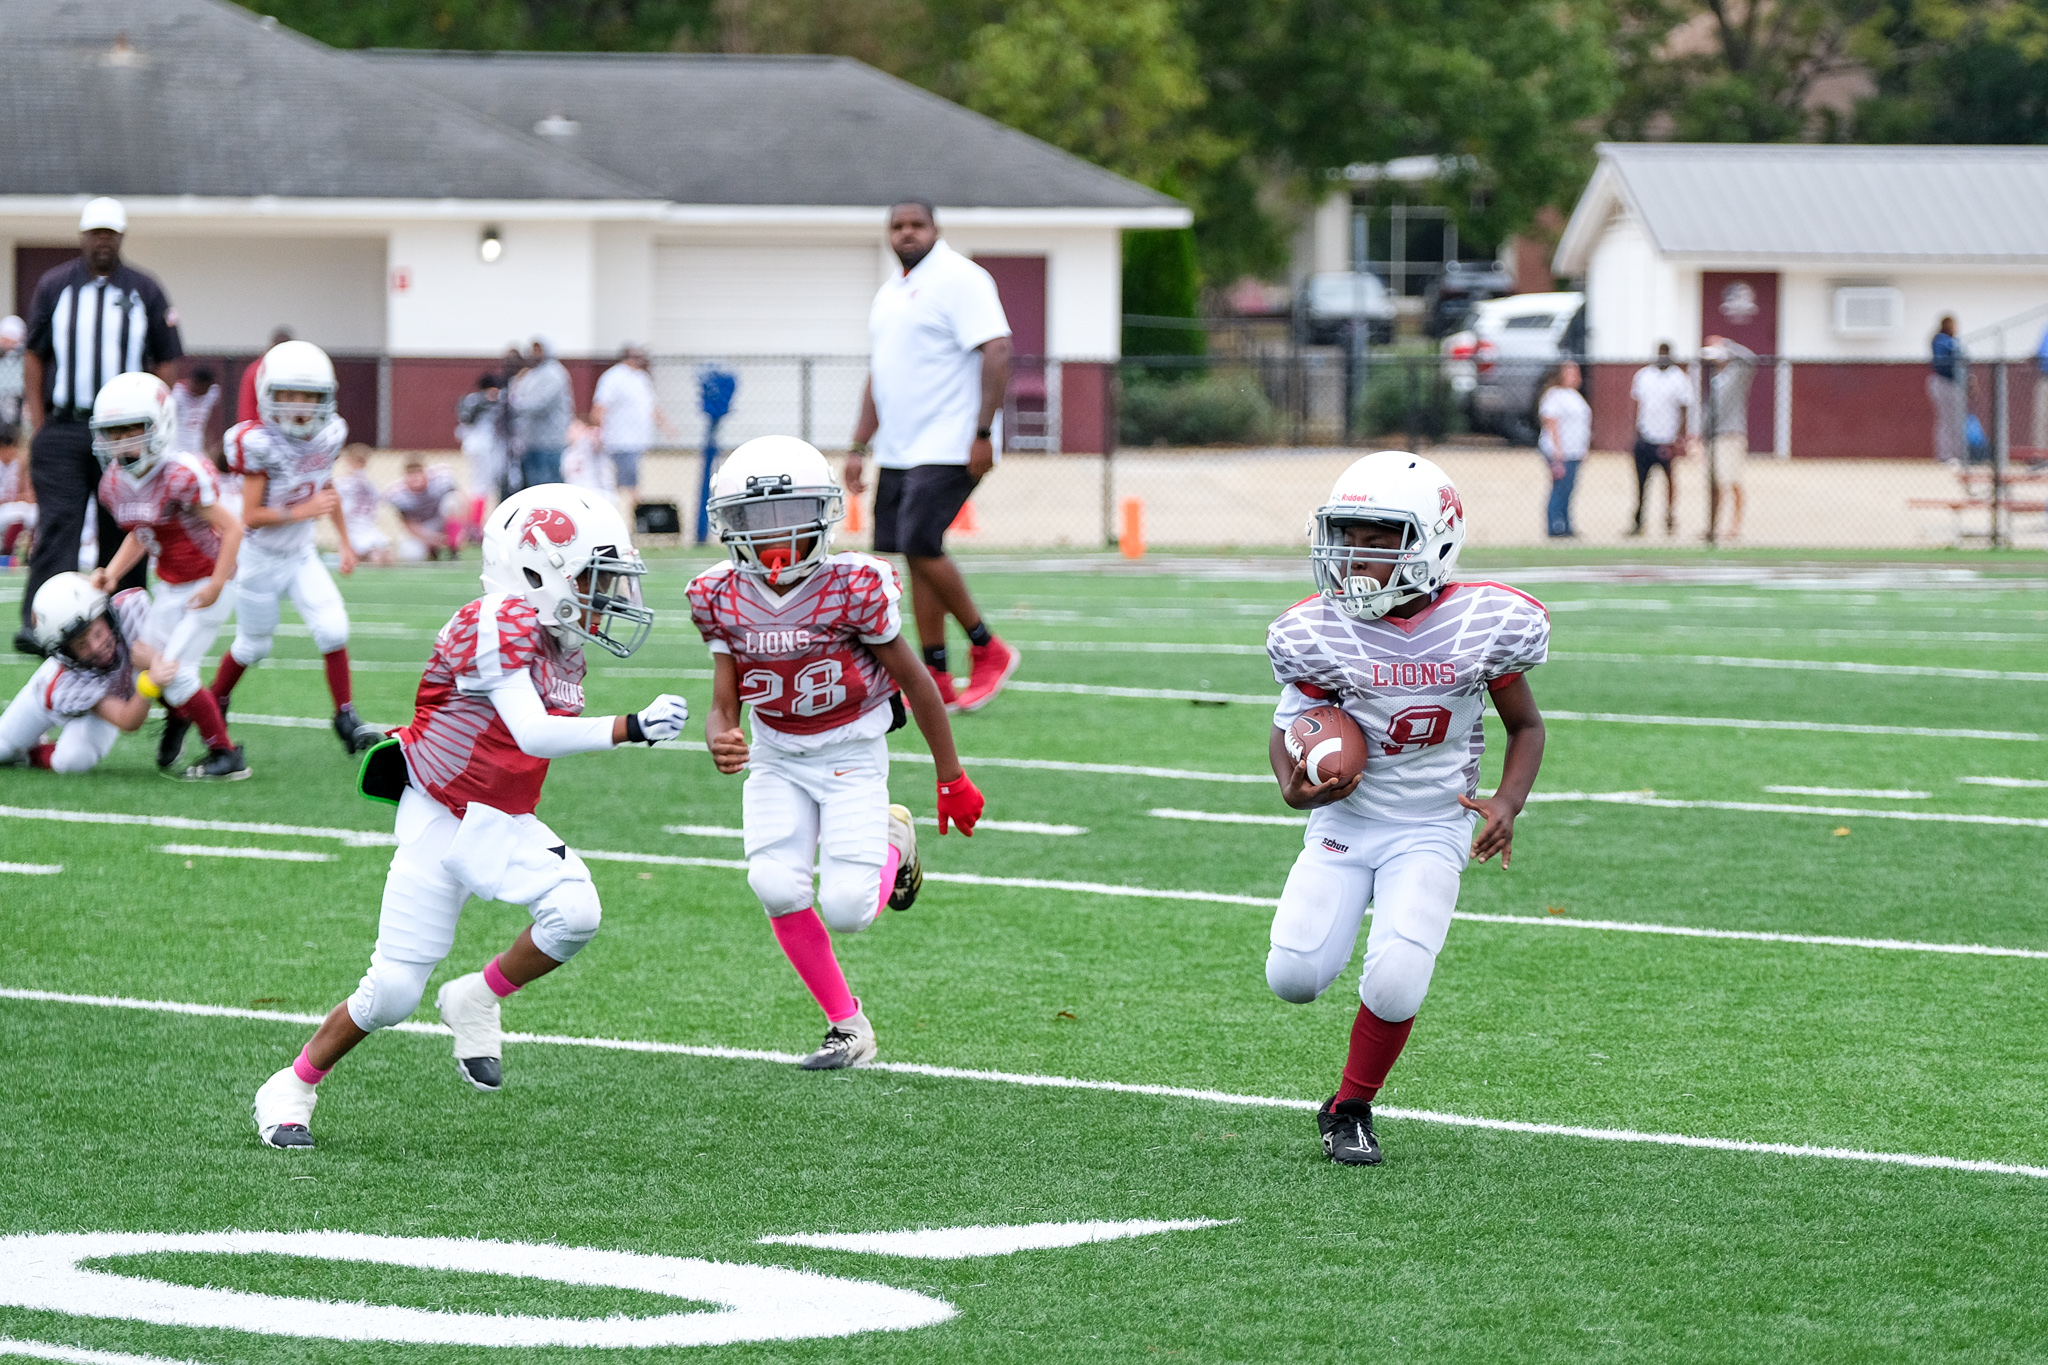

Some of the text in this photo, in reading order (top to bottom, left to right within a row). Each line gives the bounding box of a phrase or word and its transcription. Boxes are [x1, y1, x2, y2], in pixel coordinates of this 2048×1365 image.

[1341, 494, 1368, 502] Riddell
[745, 630, 812, 654] LIONS
[739, 658, 847, 718] 28
[1371, 663, 1457, 687] LIONS
[549, 676, 585, 708] LIONS
[1380, 704, 1453, 756] 9
